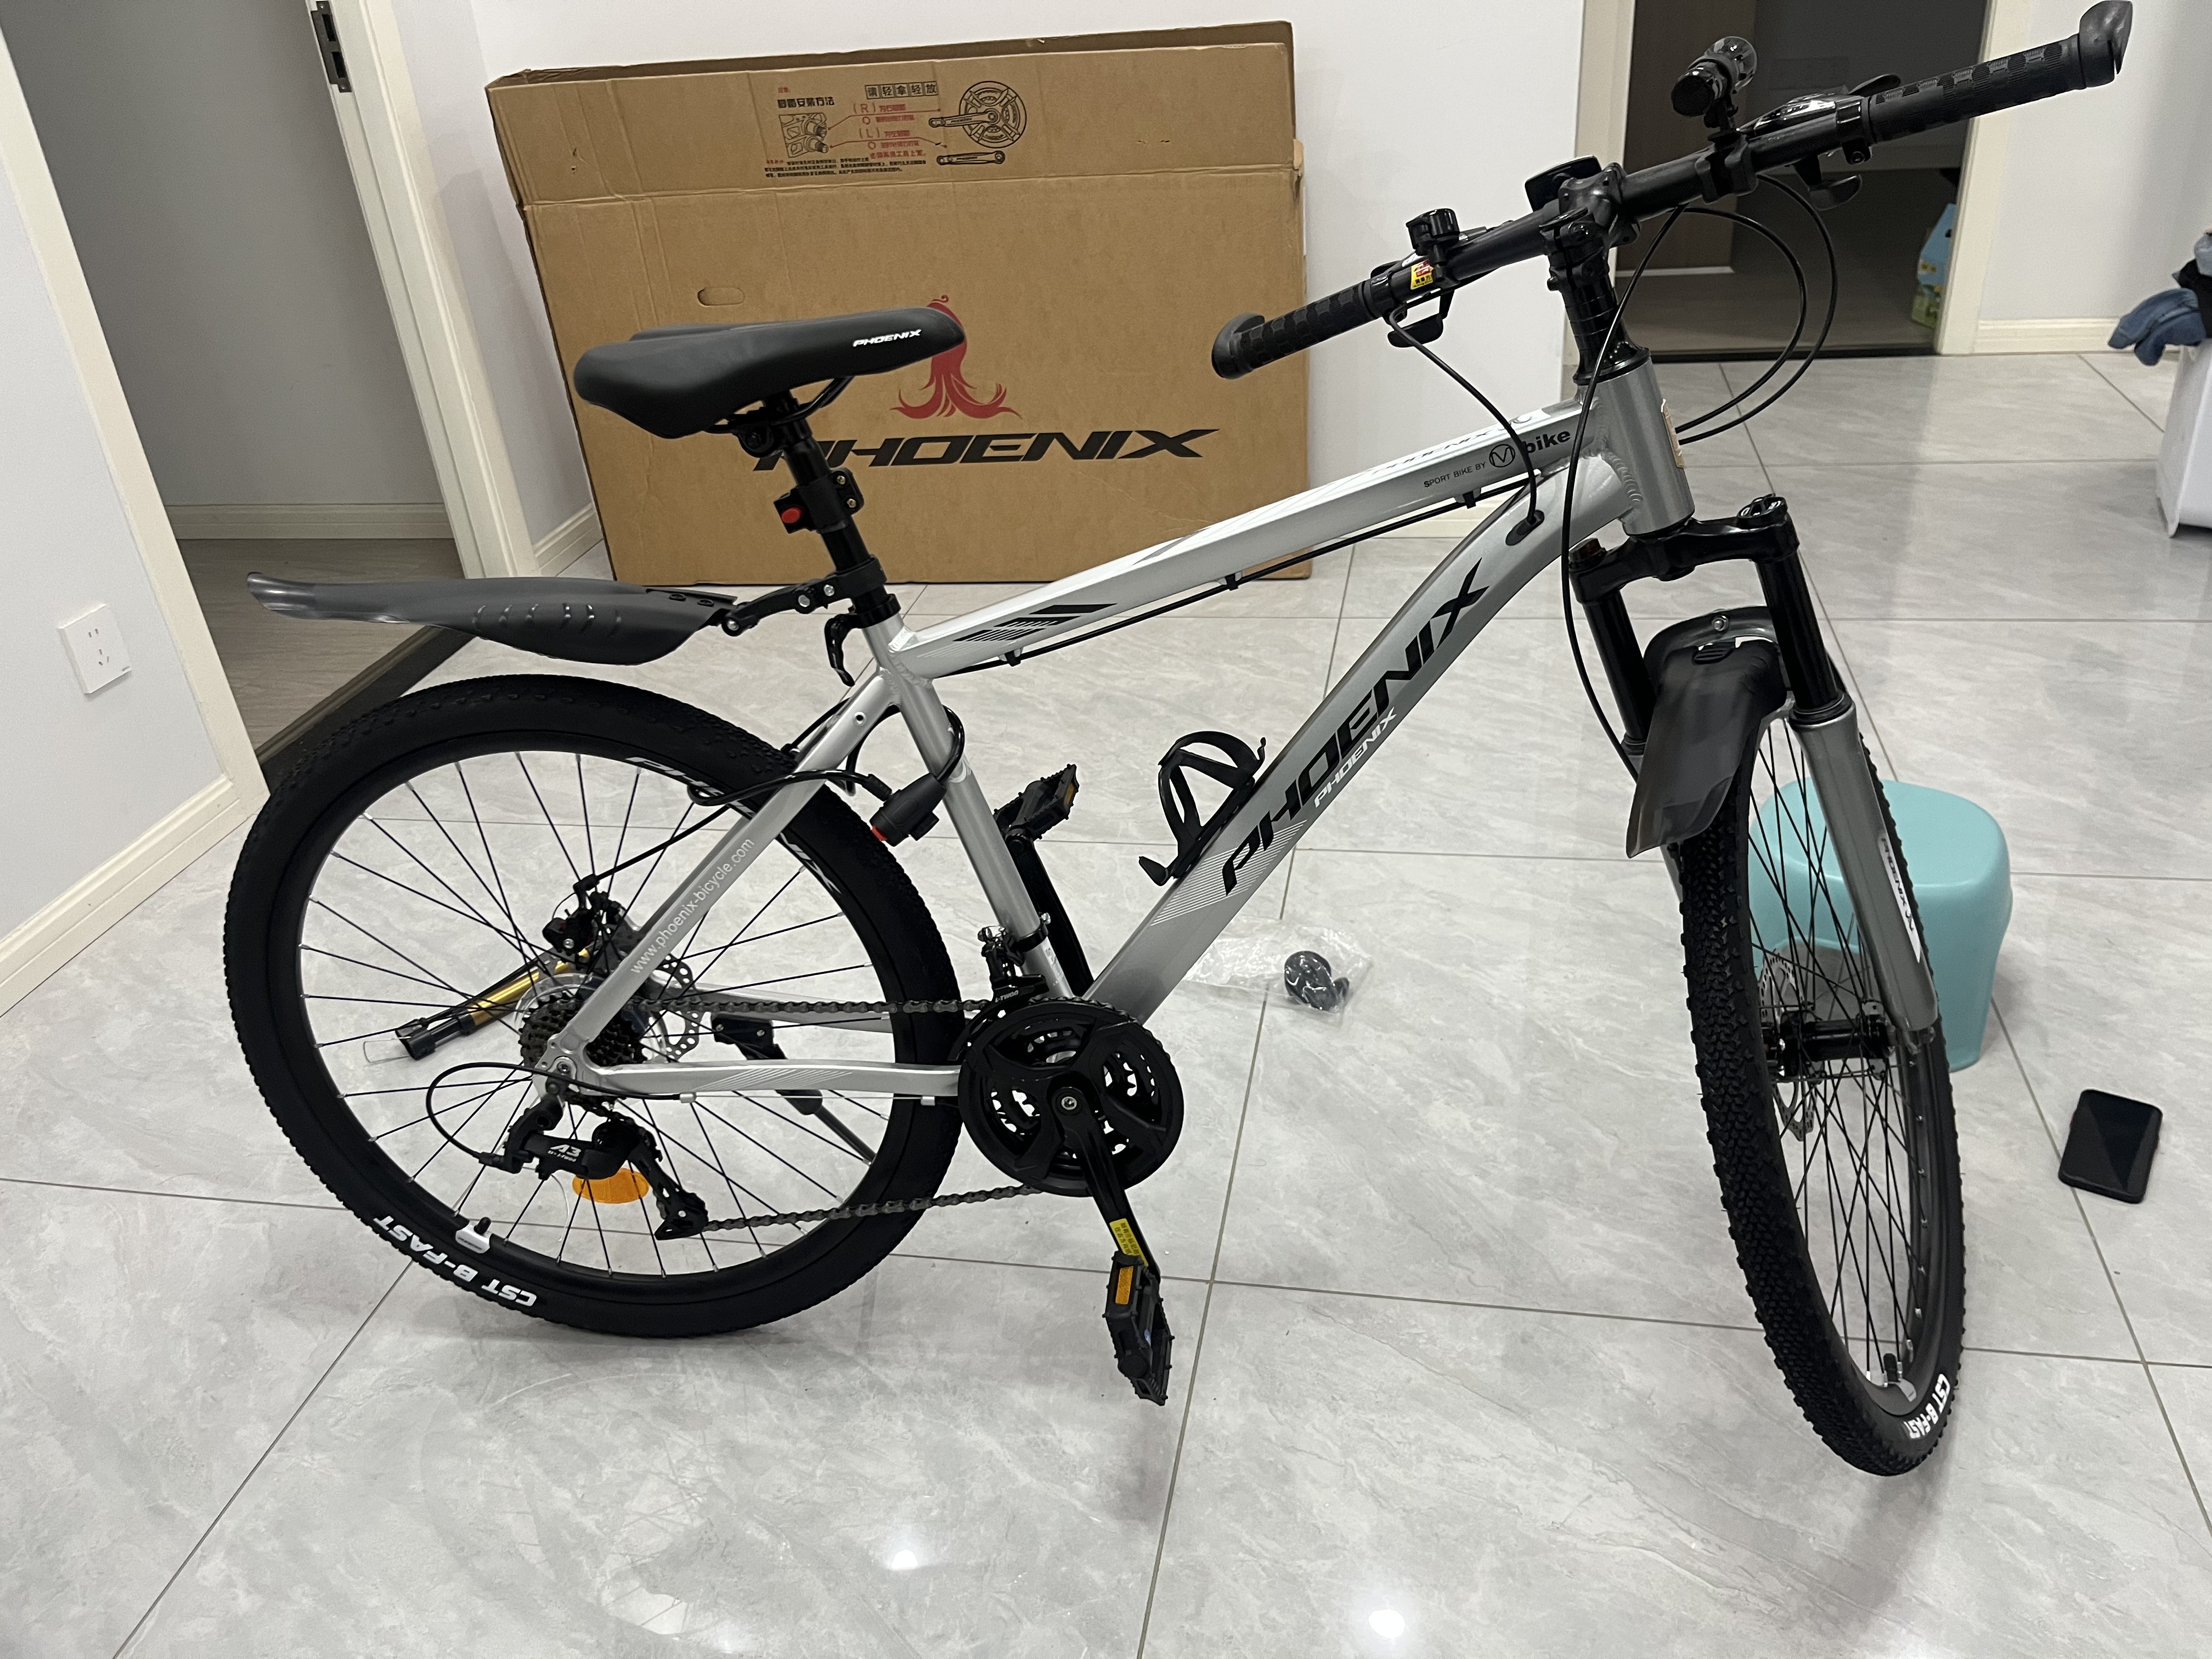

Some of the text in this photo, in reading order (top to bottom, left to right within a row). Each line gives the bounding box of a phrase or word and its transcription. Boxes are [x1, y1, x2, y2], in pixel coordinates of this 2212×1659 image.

[853, 329, 922, 347] PHOENIX
[1424, 473, 1450, 488] SPORT
[1454, 467, 1473, 478] BIKE
[1476, 461, 1486, 471] BY
[1521, 431, 1571, 453] bike
[1222, 557, 1490, 896] PHOENIX
[1314, 707, 1396, 808] PHOENIX
[631, 838, 755, 974] www.phoenix-bicycle.com
[995, 990, 1019, 1003] L-TWOO
[550, 1144, 582, 1157] A3
[373, 1216, 537, 1307] CST B-FAST
[1932, 1373, 1951, 1414] CST
